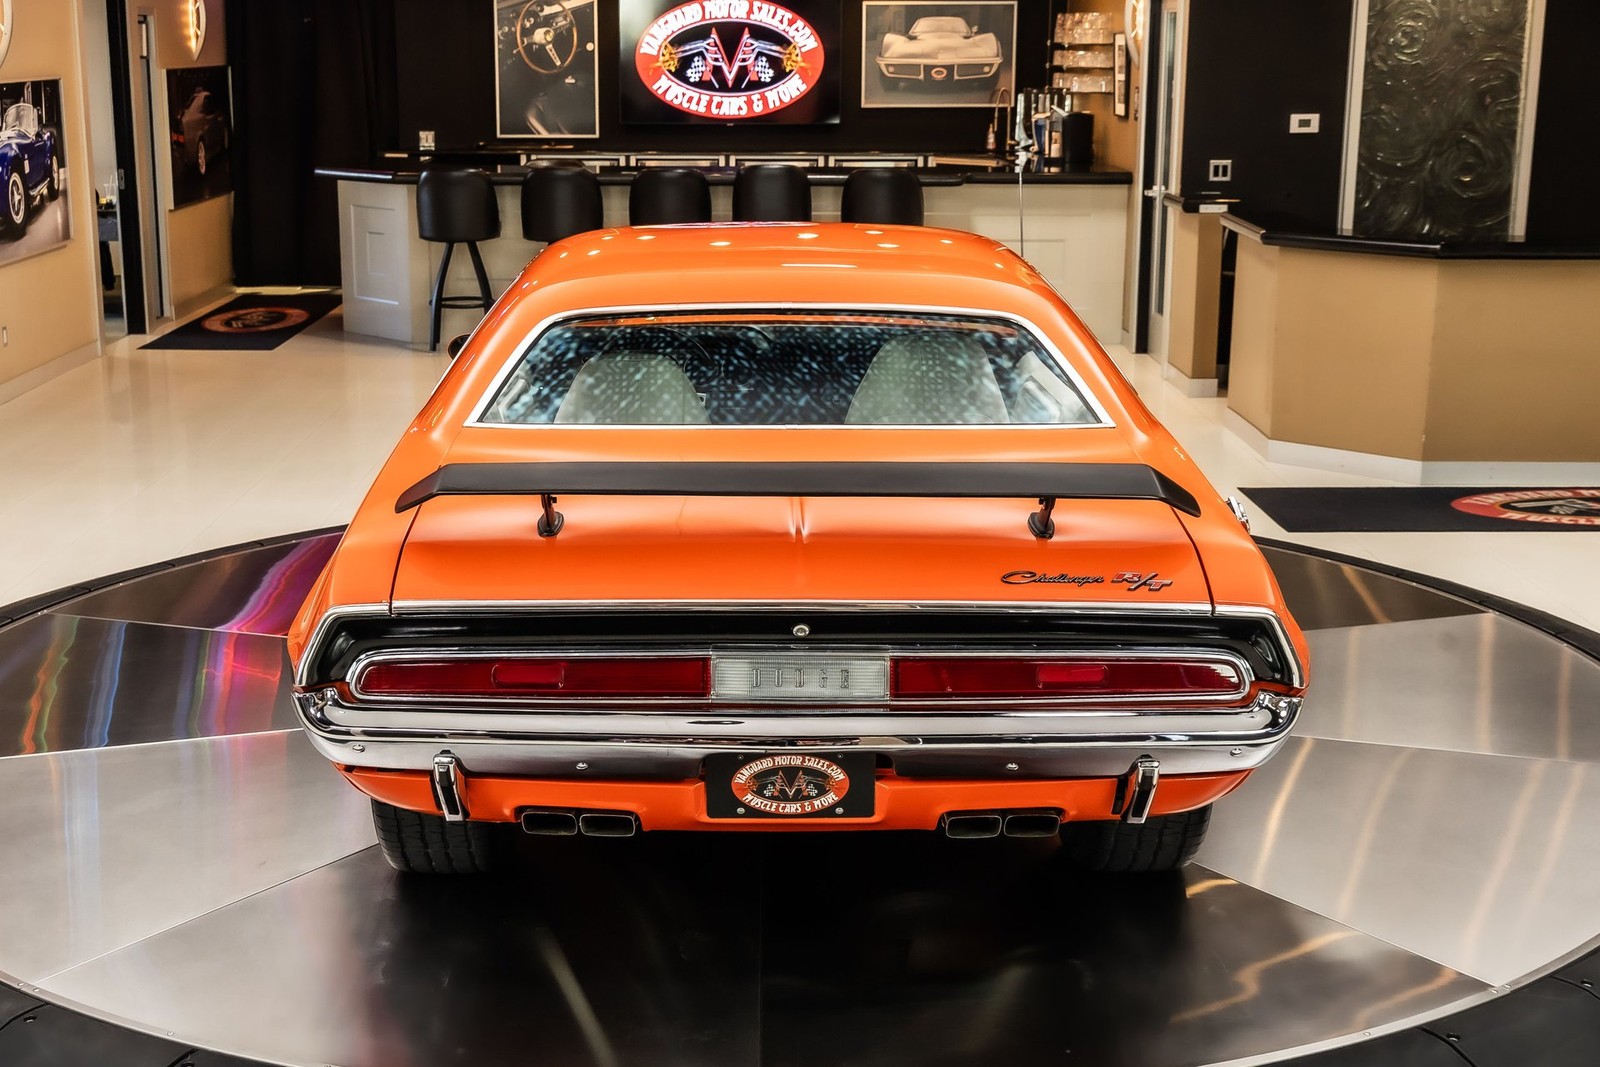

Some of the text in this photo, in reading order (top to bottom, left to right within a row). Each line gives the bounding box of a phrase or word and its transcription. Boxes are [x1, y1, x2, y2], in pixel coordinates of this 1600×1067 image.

[640, 0, 818, 56] VANGUARD MOTOR SALES.COM
[652, 74, 807, 116] MUSCLE CARS & MORE
[1001, 570, 1173, 591] Challenger R/T
[752, 668, 850, 688] DODGE
[734, 755, 845, 784] VANGUARD MOTOR SALES.COM
[742, 791, 839, 813] MUSCLE CARS & MORE
